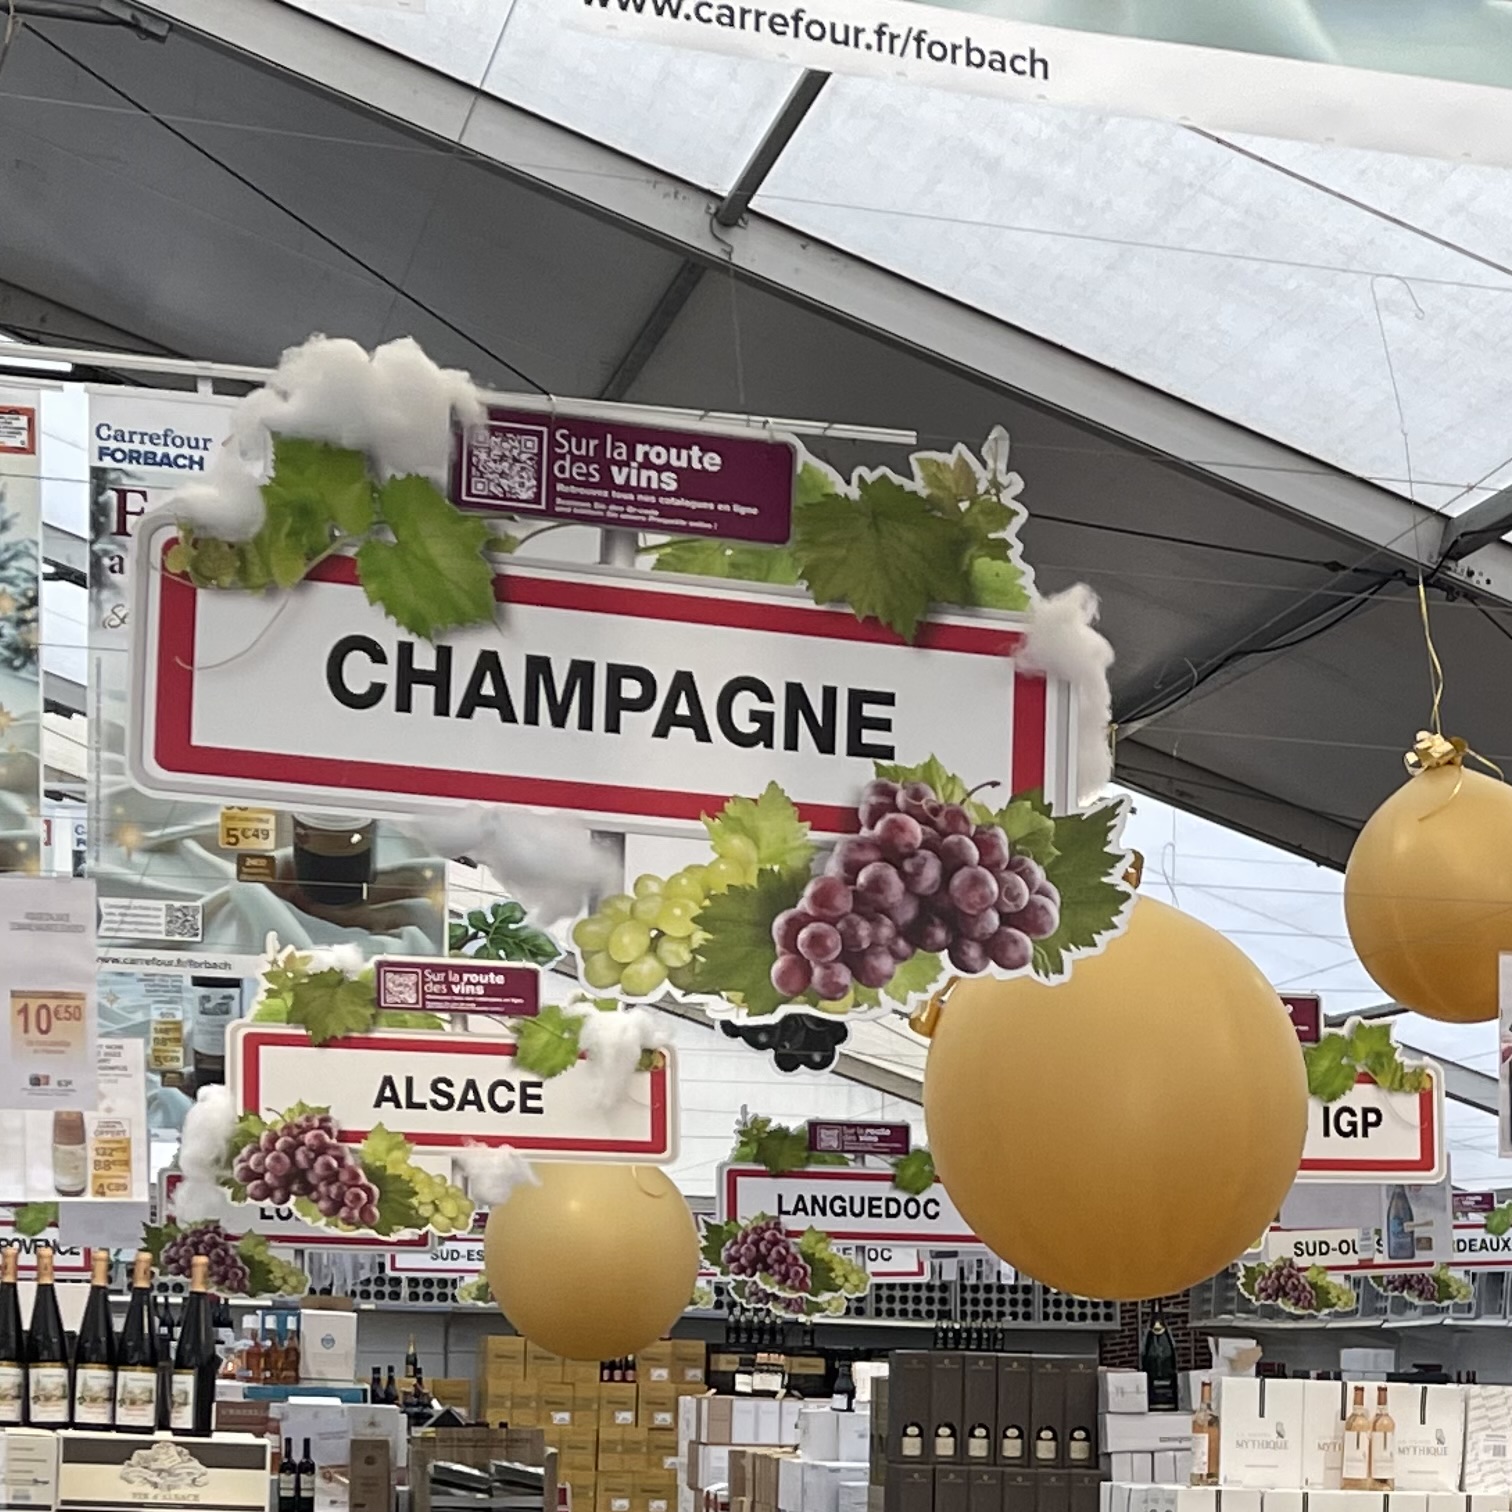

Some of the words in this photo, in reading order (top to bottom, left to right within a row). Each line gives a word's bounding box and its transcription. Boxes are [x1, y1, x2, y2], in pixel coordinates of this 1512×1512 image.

[583, 0, 1049, 81] ww.carrefour.fr/forbach
[95, 423, 212, 451] Carrefour
[97, 446, 204, 471] FORBACH
[554, 429, 599, 458] Sur
[606, 433, 628, 460] la
[635, 443, 722, 472] route
[553, 456, 600, 482] des
[611, 463, 678, 491] vins
[325, 635, 897, 761] CHAMPAGNE
[224, 827, 270, 847] 5€49
[424, 969, 446, 983] Sur
[448, 970, 460, 983] la
[462, 971, 505, 985] route
[424, 982, 447, 994] des
[451, 983, 485, 996] vins
[16, 1002, 82, 1035] 10€50
[373, 1074, 544, 1115] ALSACE
[1322, 1105, 1383, 1138] IGP
[777, 1194, 941, 1220] LANGUEDOC
[430, 1247, 485, 1262] SUD-ES
[1454, 1236, 1512, 1254] DEAUX
[1235, 1439, 1289, 1450] MYTHIQUE
[1397, 1446, 1448, 1456] MYTHIQUE
